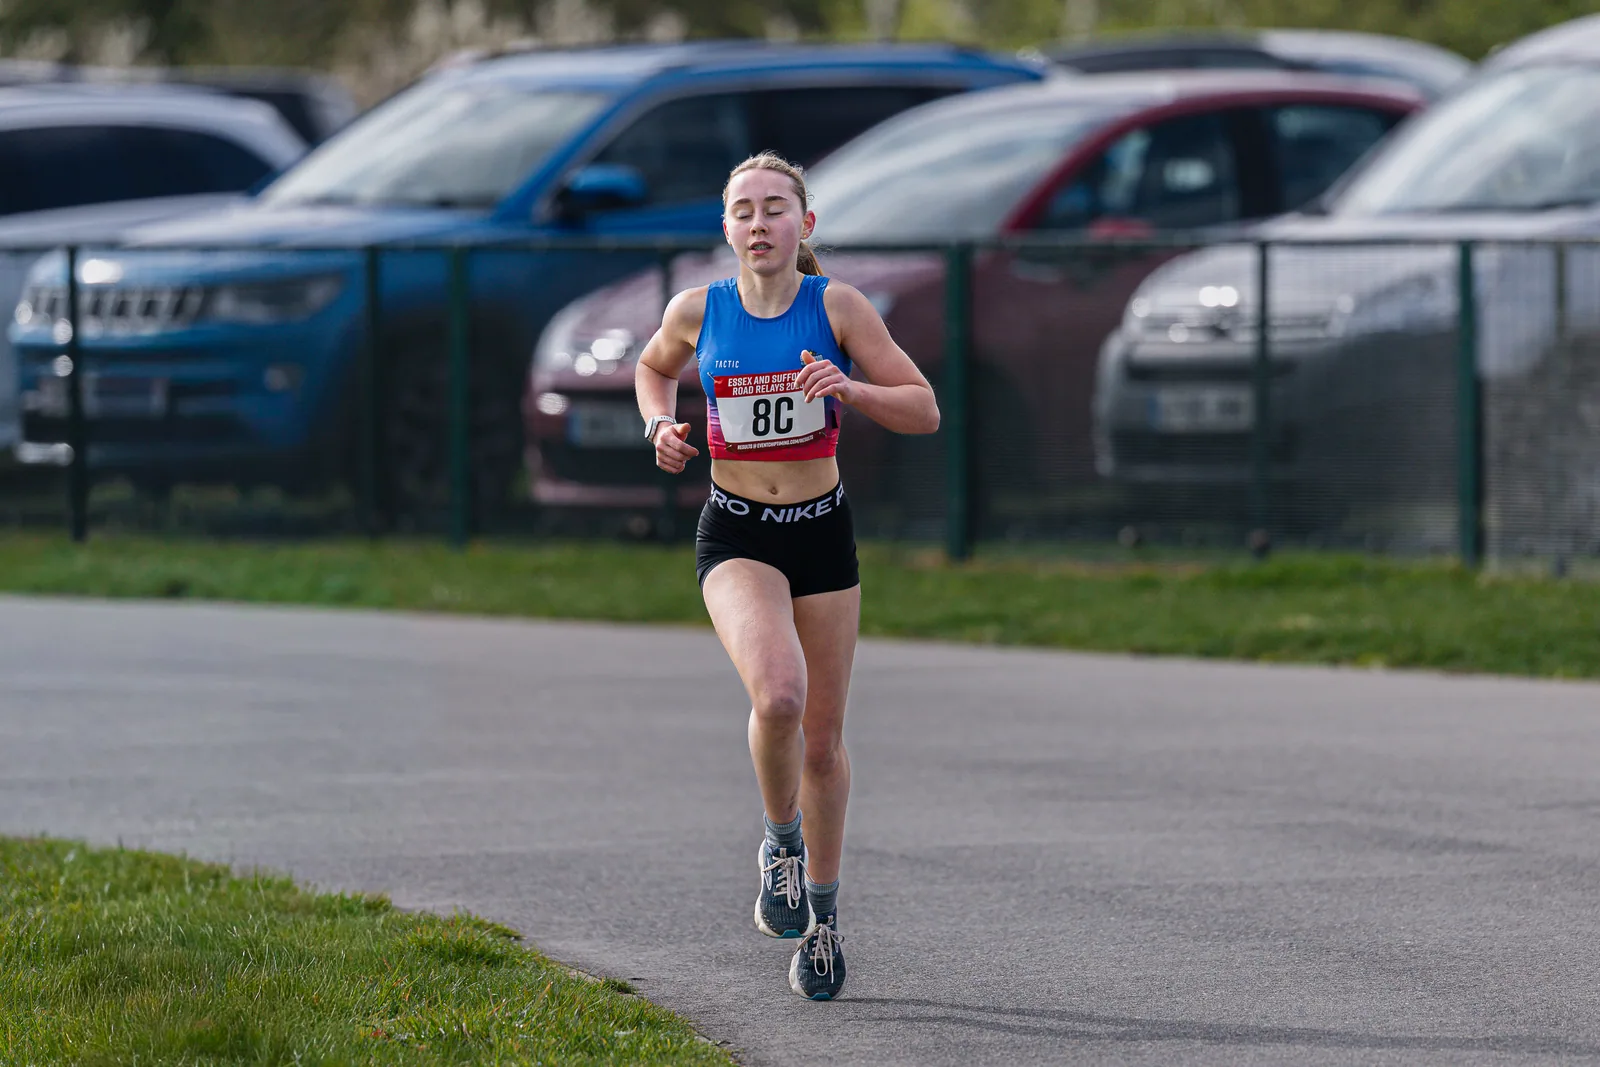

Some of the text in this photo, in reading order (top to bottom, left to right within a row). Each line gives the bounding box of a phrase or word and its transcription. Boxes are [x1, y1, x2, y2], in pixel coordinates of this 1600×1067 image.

[715, 360, 740, 369] TACTIC
[728, 371, 801, 387] ESSEX AND SUFFO
[732, 385, 754, 396] ROAD
[755, 382, 785, 394] RELAYS
[752, 396, 794, 437] 8C
[760, 496, 832, 523] NIKE
